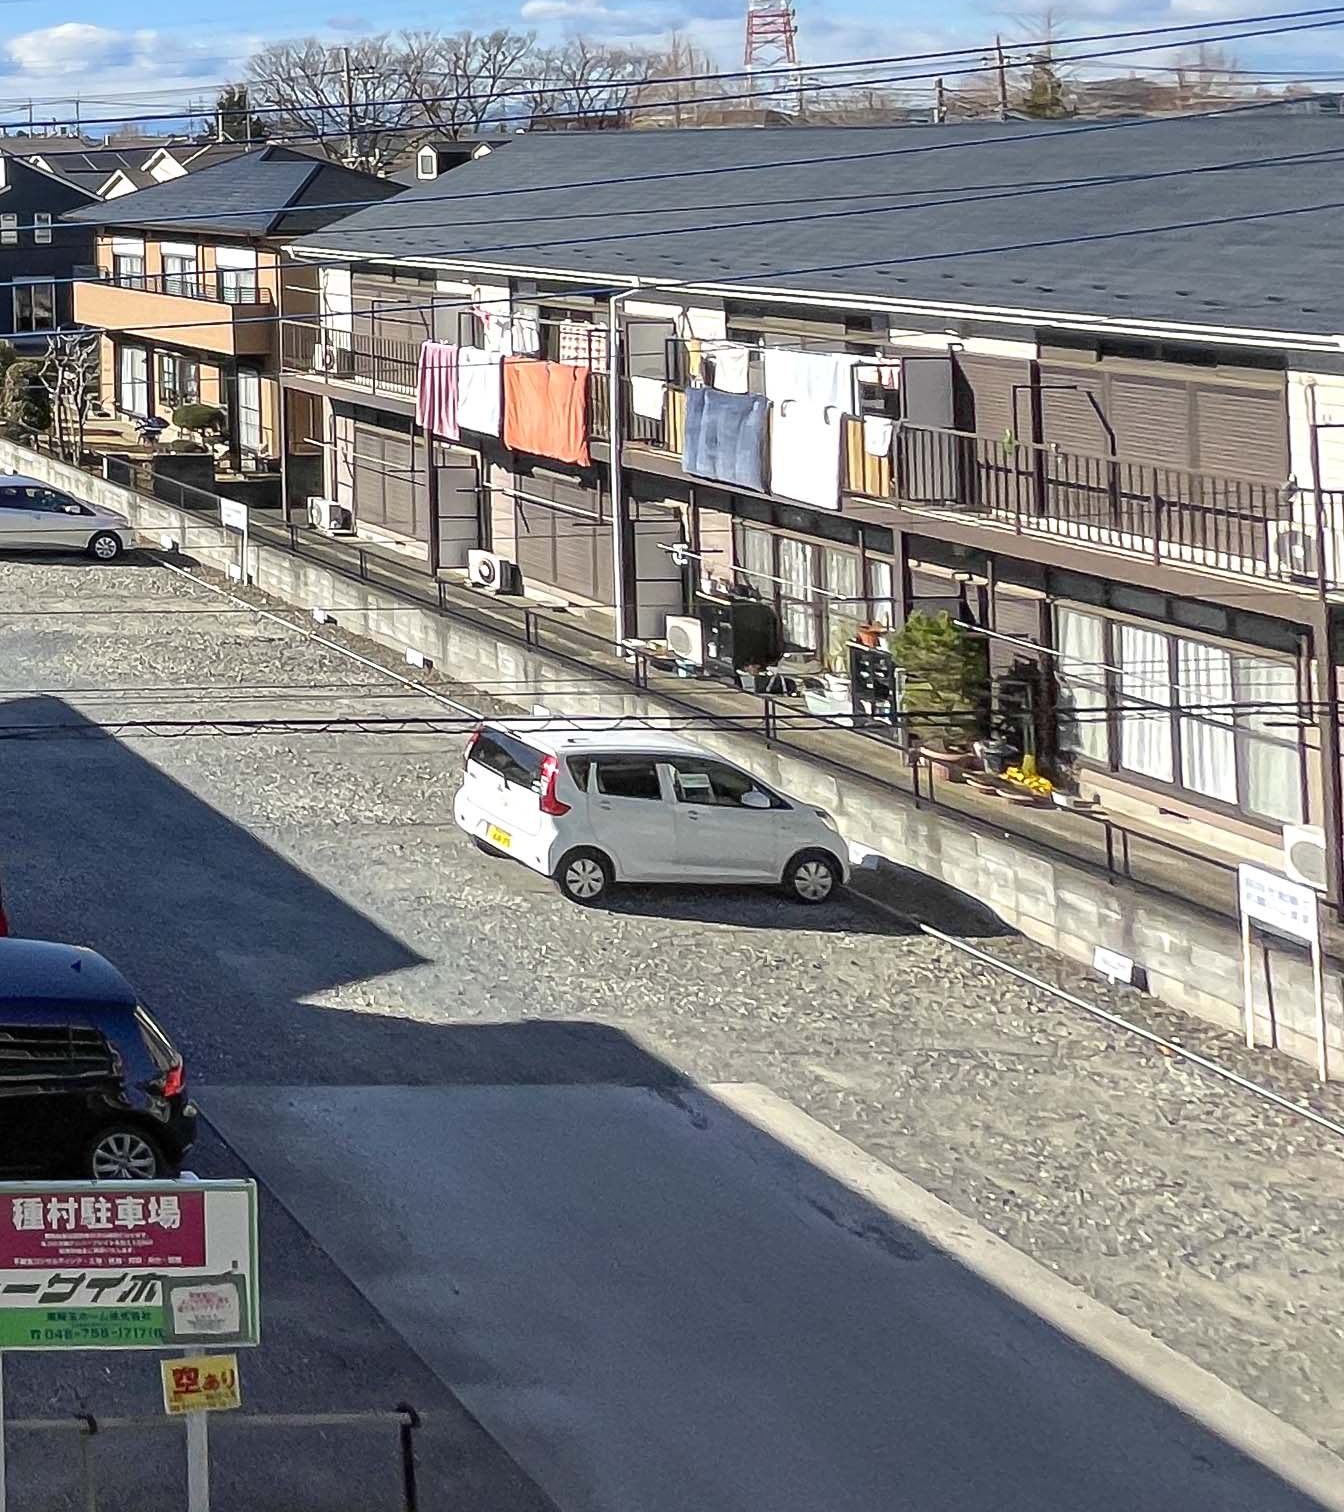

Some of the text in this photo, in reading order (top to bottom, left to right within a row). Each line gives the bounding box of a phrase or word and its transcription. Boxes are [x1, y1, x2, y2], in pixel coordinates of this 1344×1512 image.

[12, 1196, 182, 1231] 種村駐車場
